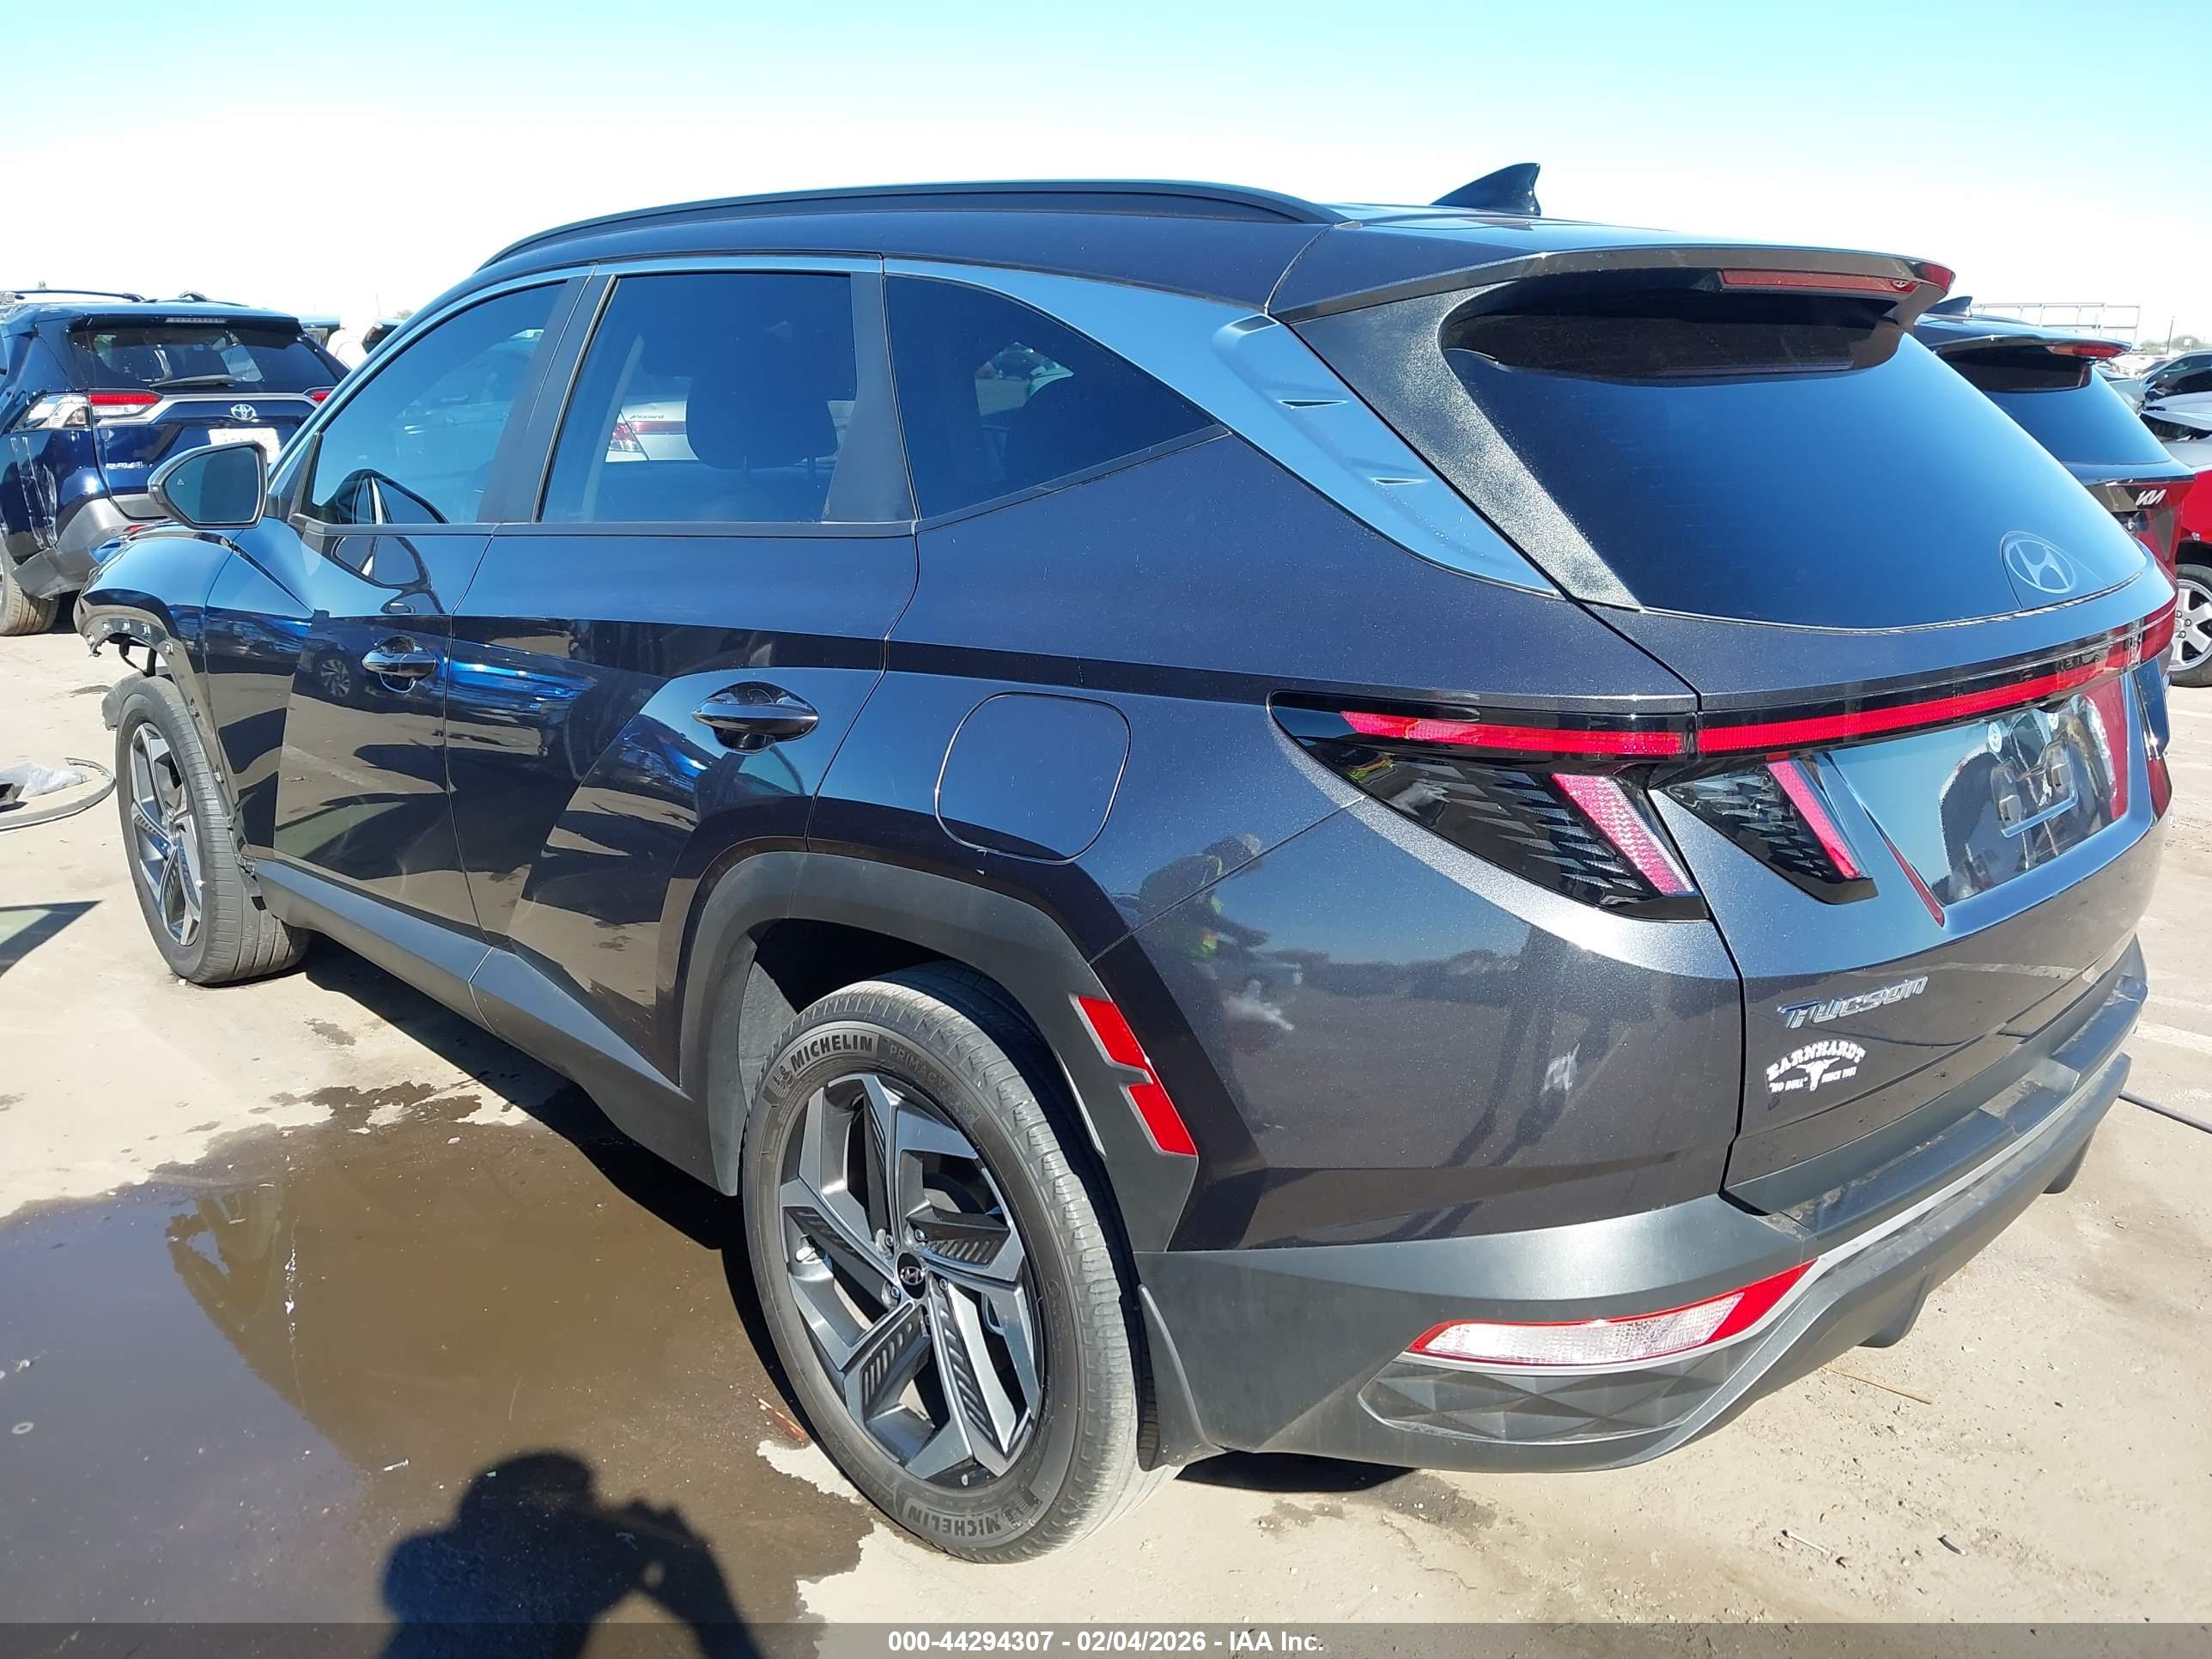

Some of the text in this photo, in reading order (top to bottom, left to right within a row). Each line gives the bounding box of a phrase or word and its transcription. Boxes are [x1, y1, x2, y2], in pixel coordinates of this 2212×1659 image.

[1777, 975, 1929, 1029] TUCSON
[790, 1034, 873, 1073] MICHELIN
[1766, 1041, 1866, 1082] EARNHARDT
[907, 1504, 1002, 1537] MICHELIN
